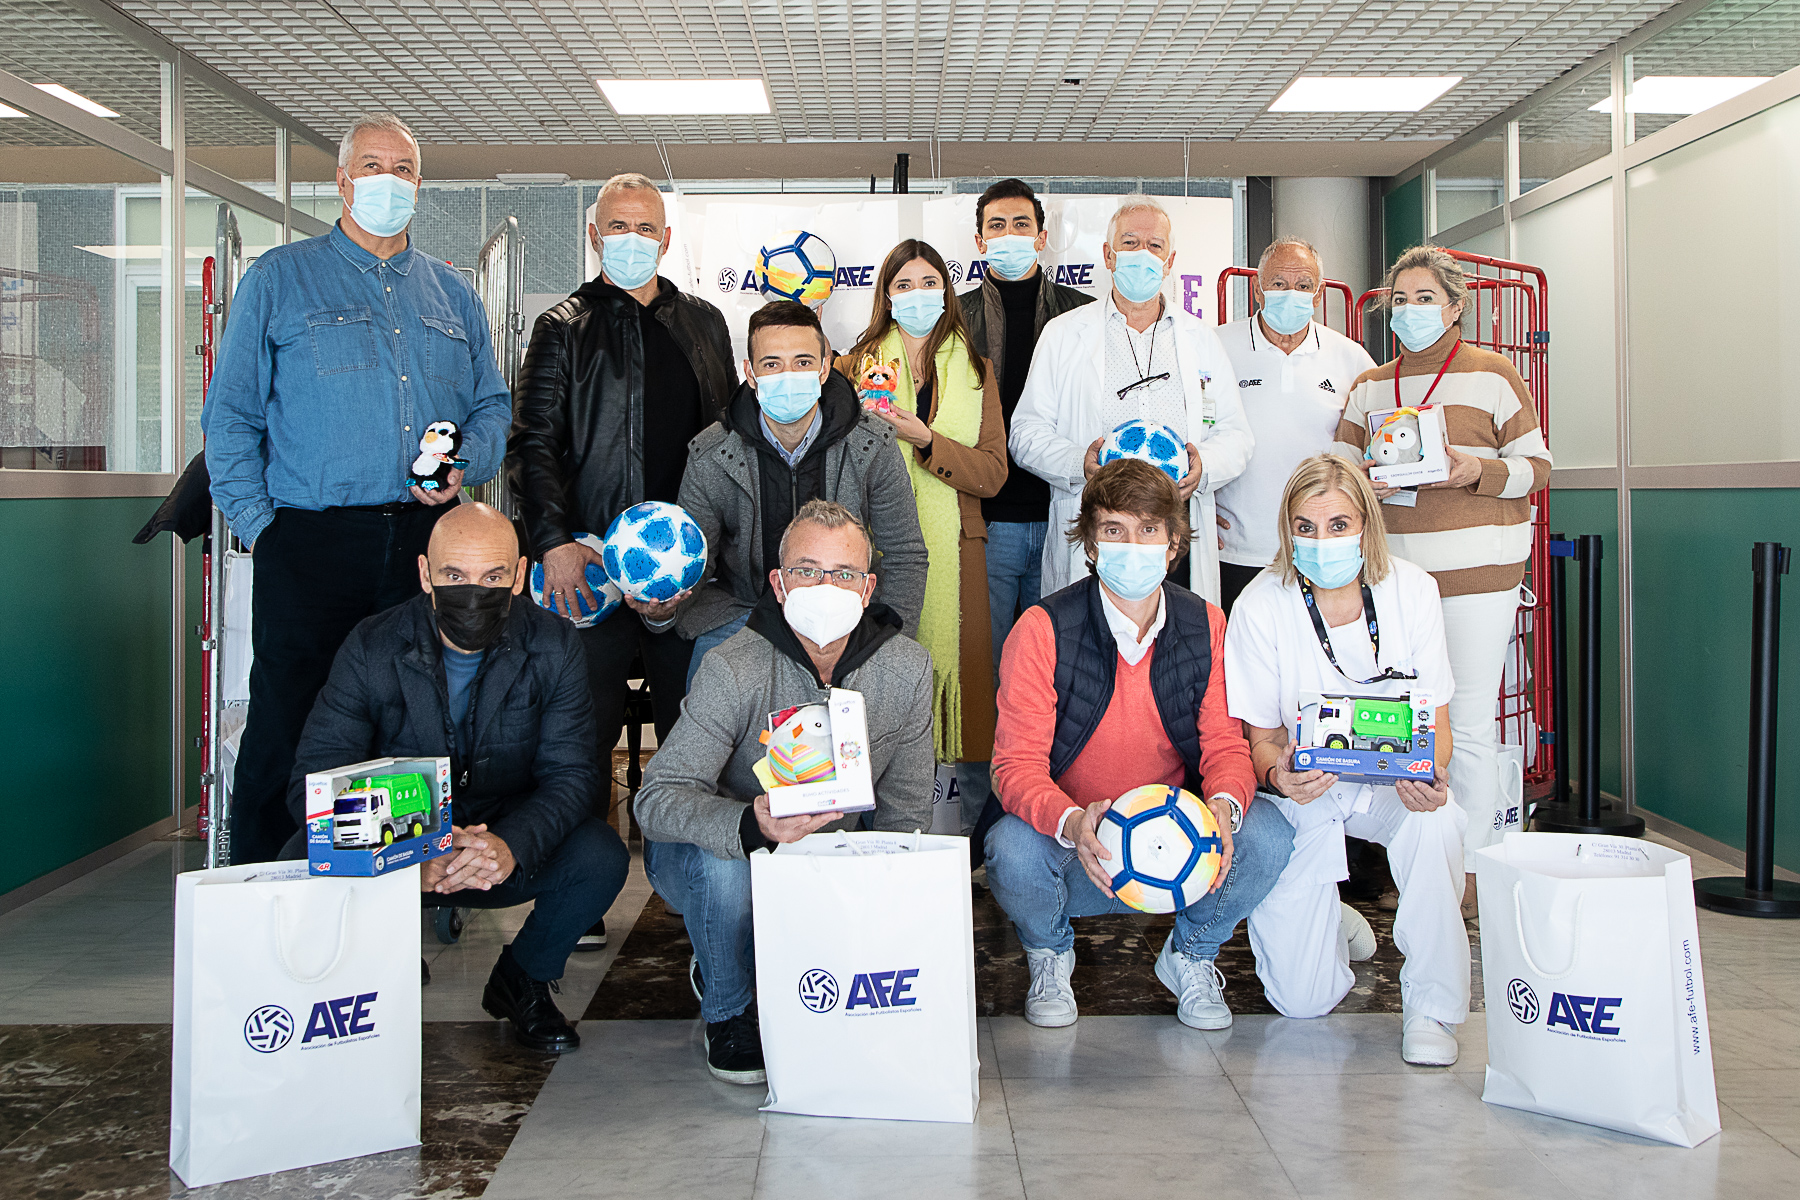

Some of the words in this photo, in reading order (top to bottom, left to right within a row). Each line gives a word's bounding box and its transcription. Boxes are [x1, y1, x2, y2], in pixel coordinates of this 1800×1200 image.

[836, 266, 875, 287] AFE
[1055, 264, 1094, 286] AFE
[1504, 806, 1519, 826] AFE
[845, 968, 920, 1010] AFE
[1682, 940, 1701, 1055] www.afe-futbol.com
[301, 992, 378, 1044] AFE
[1546, 992, 1622, 1036] AFE
